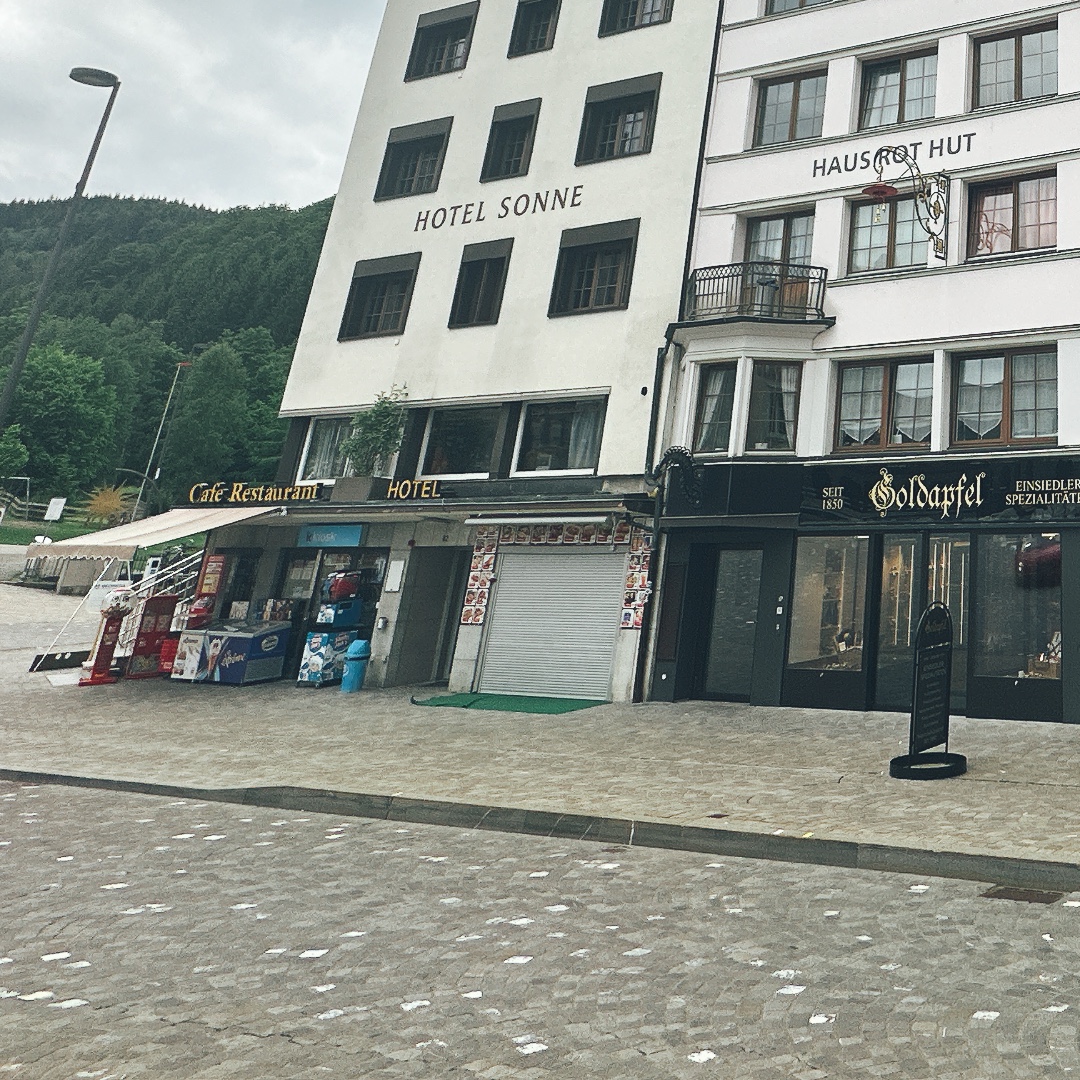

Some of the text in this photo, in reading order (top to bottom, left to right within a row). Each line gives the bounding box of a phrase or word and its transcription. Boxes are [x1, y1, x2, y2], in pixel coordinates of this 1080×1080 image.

[812, 132, 977, 178] HAUS ROT HUT
[413, 184, 584, 232] HOTEL SONNE
[228, 482, 319, 503] Restaurant
[387, 479, 441, 499] HOTEL
[822, 486, 845, 498] SEIT
[868, 467, 987, 520] Goldapfel
[822, 498, 844, 510] 1850
